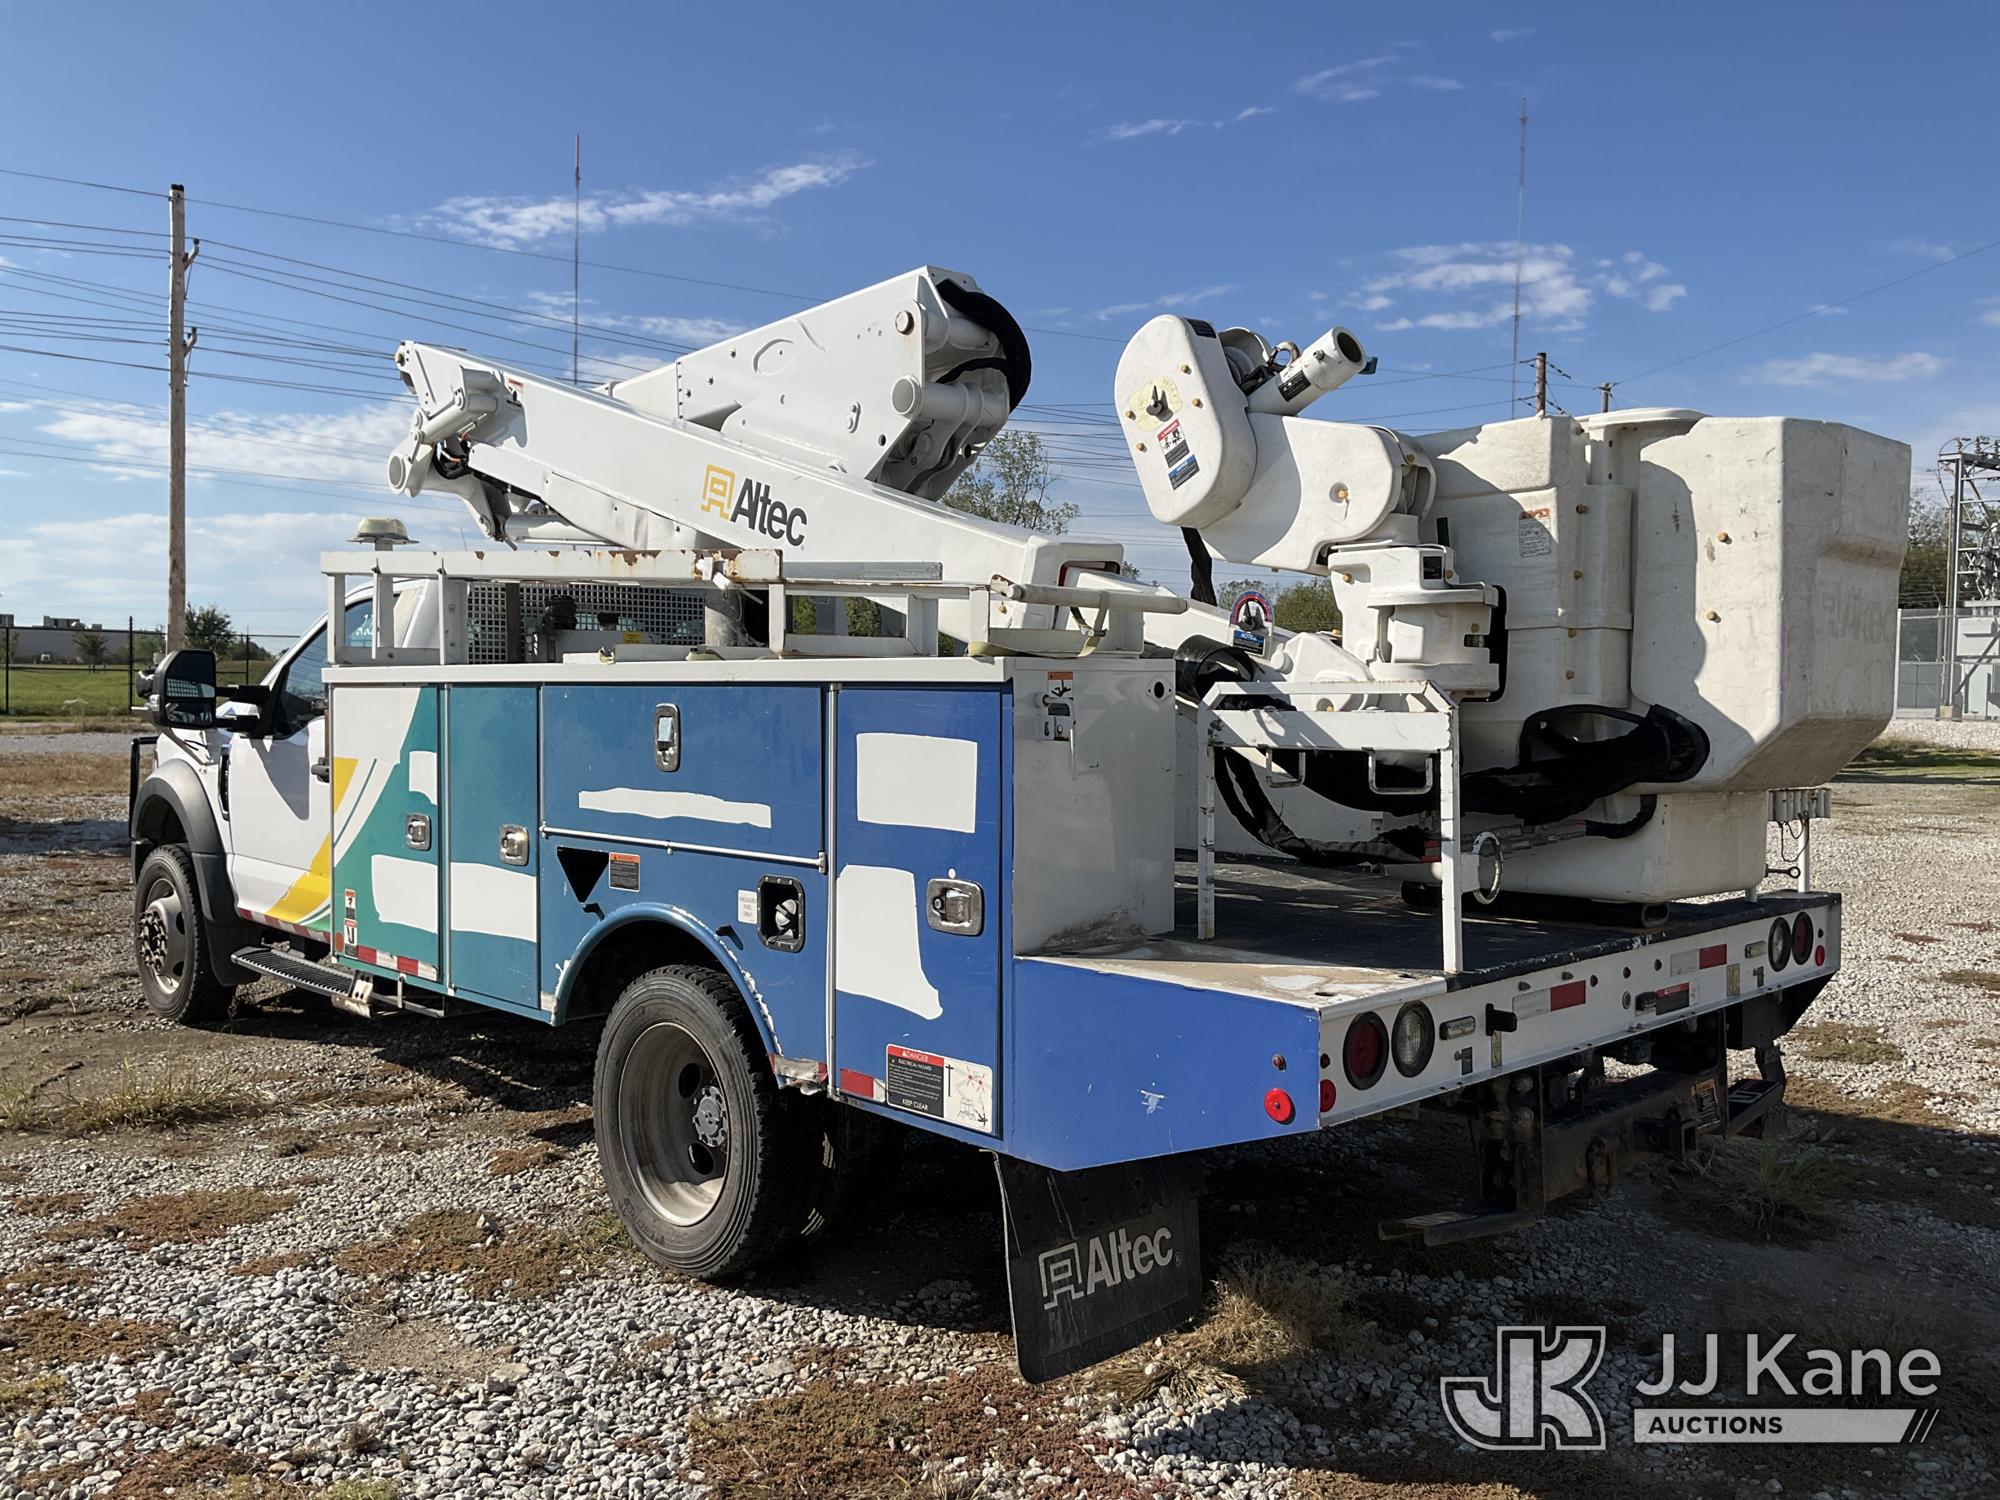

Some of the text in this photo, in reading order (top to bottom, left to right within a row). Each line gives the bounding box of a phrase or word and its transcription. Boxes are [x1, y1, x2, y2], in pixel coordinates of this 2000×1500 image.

[729, 477, 808, 547] Altec
[905, 1050, 929, 1061] DANGER
[902, 1098, 928, 1110] KEEP CLEAR
[1086, 1227, 1173, 1296] Altec
